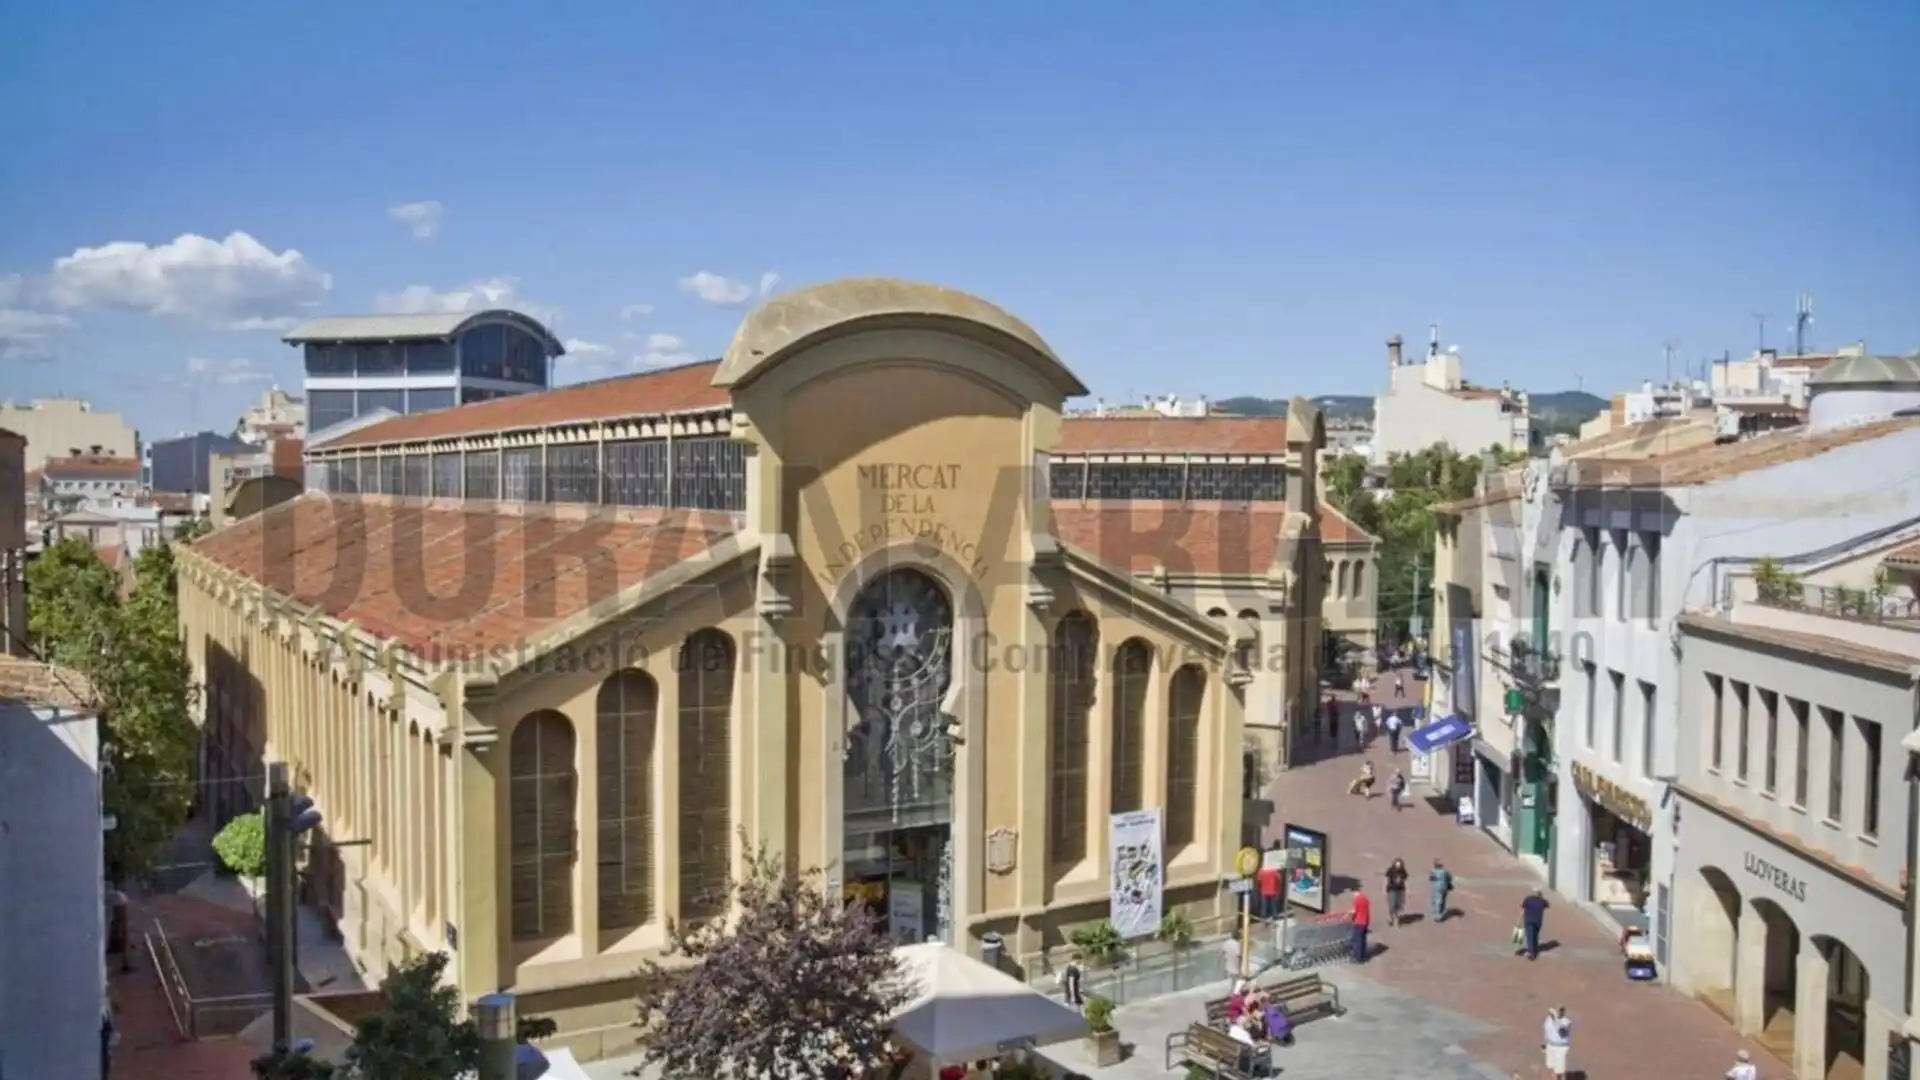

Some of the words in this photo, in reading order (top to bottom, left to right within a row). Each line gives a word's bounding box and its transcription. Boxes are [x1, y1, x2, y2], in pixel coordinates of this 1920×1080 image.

[857, 463, 962, 490] MERCAT
[881, 493, 908, 513] DE
[913, 493, 936, 515] LA
[1743, 850, 1808, 902] LLOVERAS
